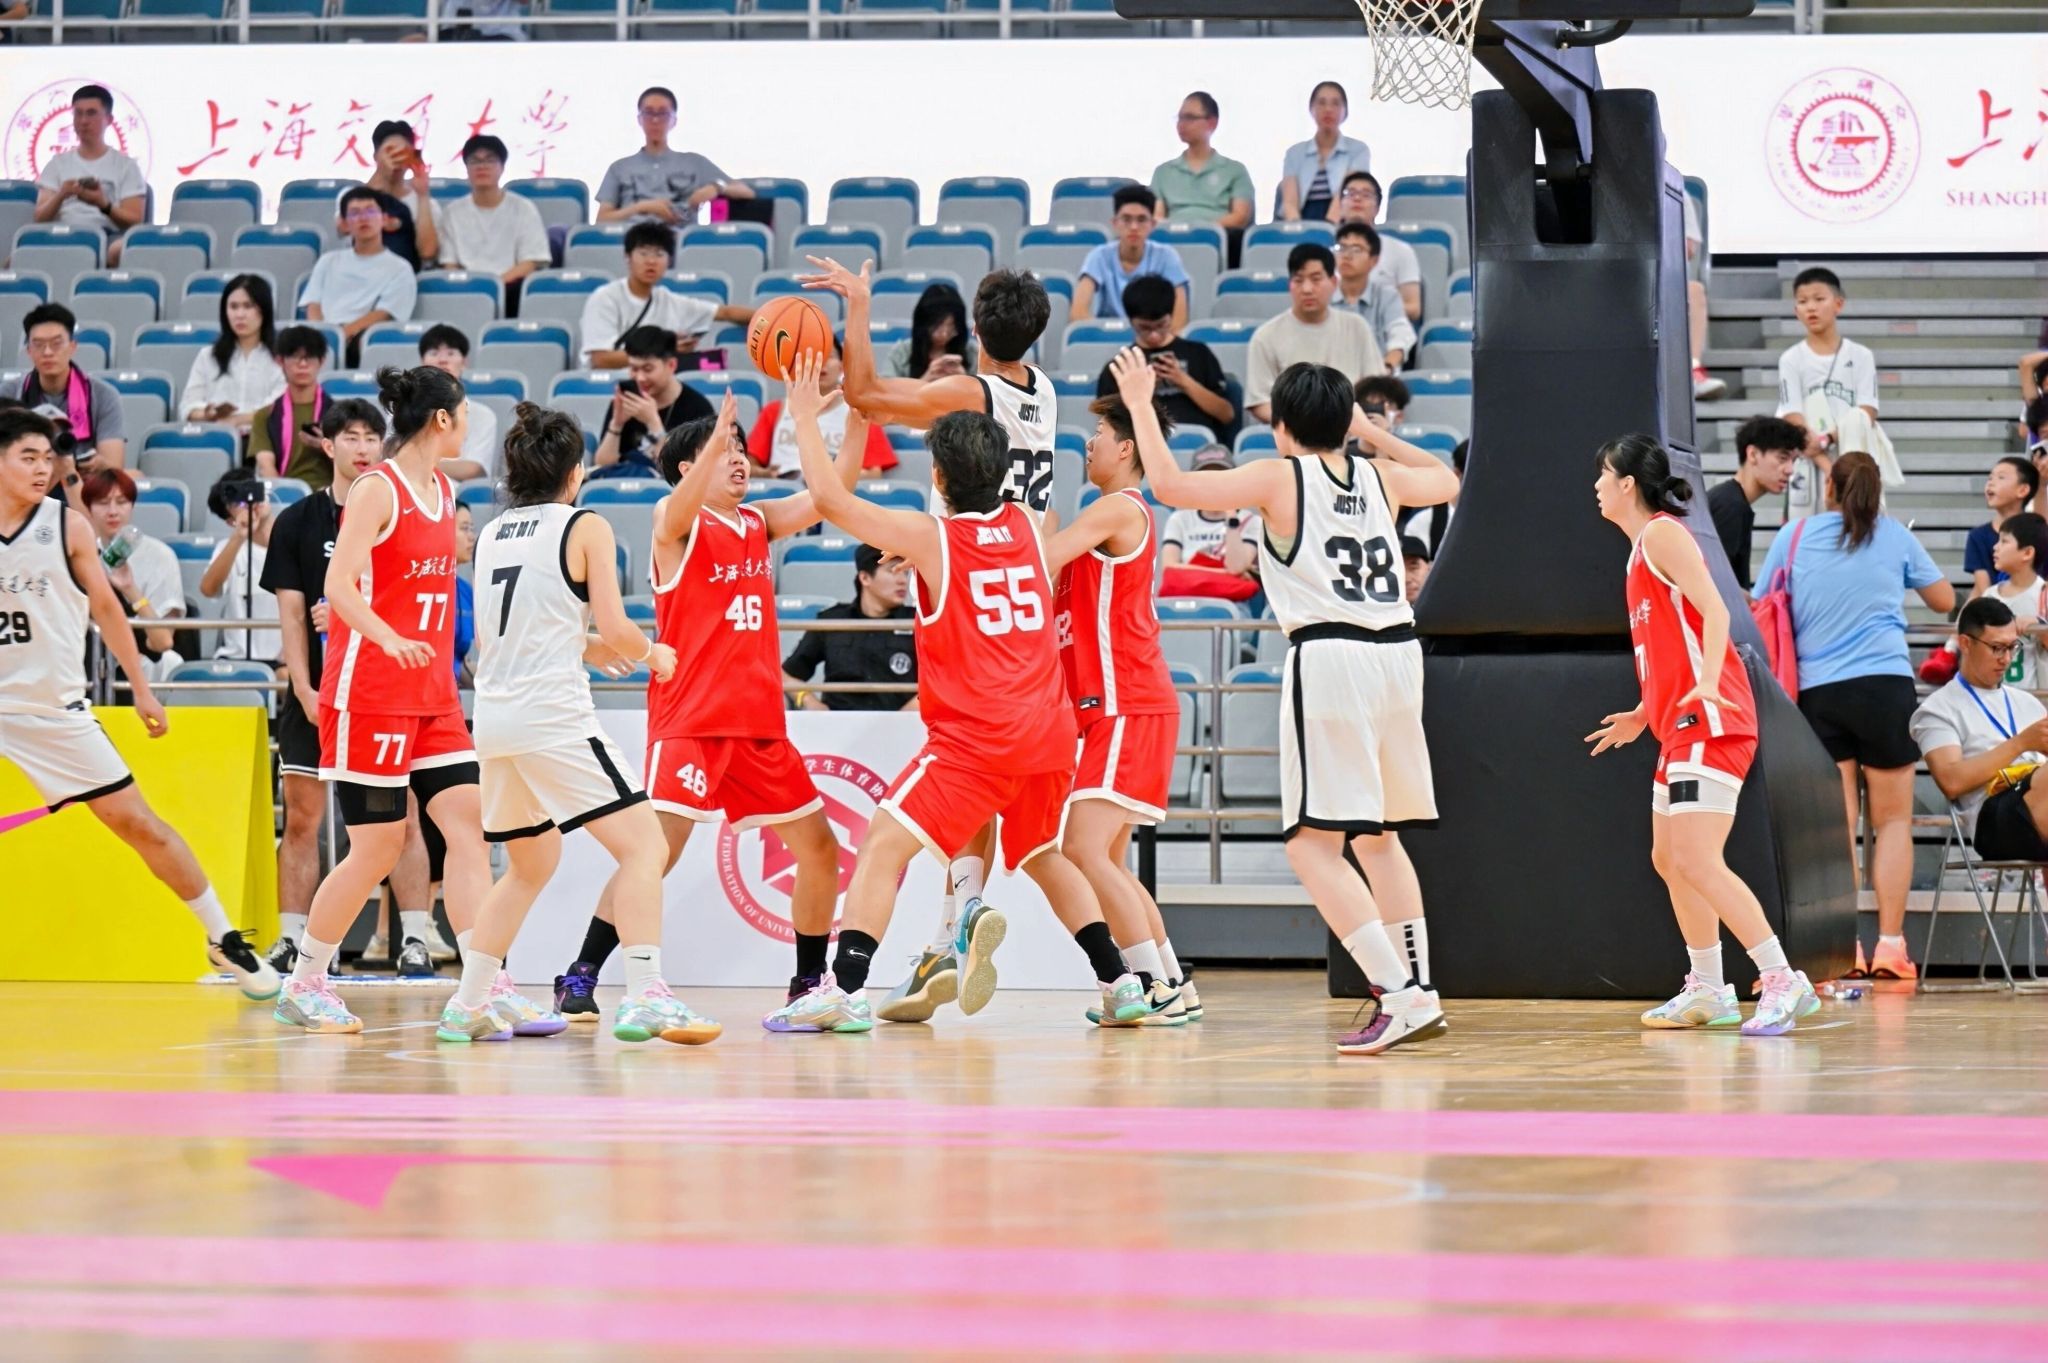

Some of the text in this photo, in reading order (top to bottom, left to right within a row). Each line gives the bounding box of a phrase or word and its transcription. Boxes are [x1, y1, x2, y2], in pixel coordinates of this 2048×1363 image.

[1946, 188, 2047, 207] SHANGH
[1001, 448, 1054, 512] 32
[1333, 494, 1358, 515] JUST
[495, 519, 540, 541] JUST DO IT
[1324, 535, 1400, 602] 38
[416, 592, 449, 632] 77
[491, 565, 523, 637] 7
[725, 594, 763, 631] 46
[969, 565, 1045, 636] 55
[0, 611, 32, 646] 29
[373, 733, 407, 765] 77
[675, 762, 708, 798] 46
[722, 836, 746, 905] FEDERATION
[743, 903, 759, 918] OF
